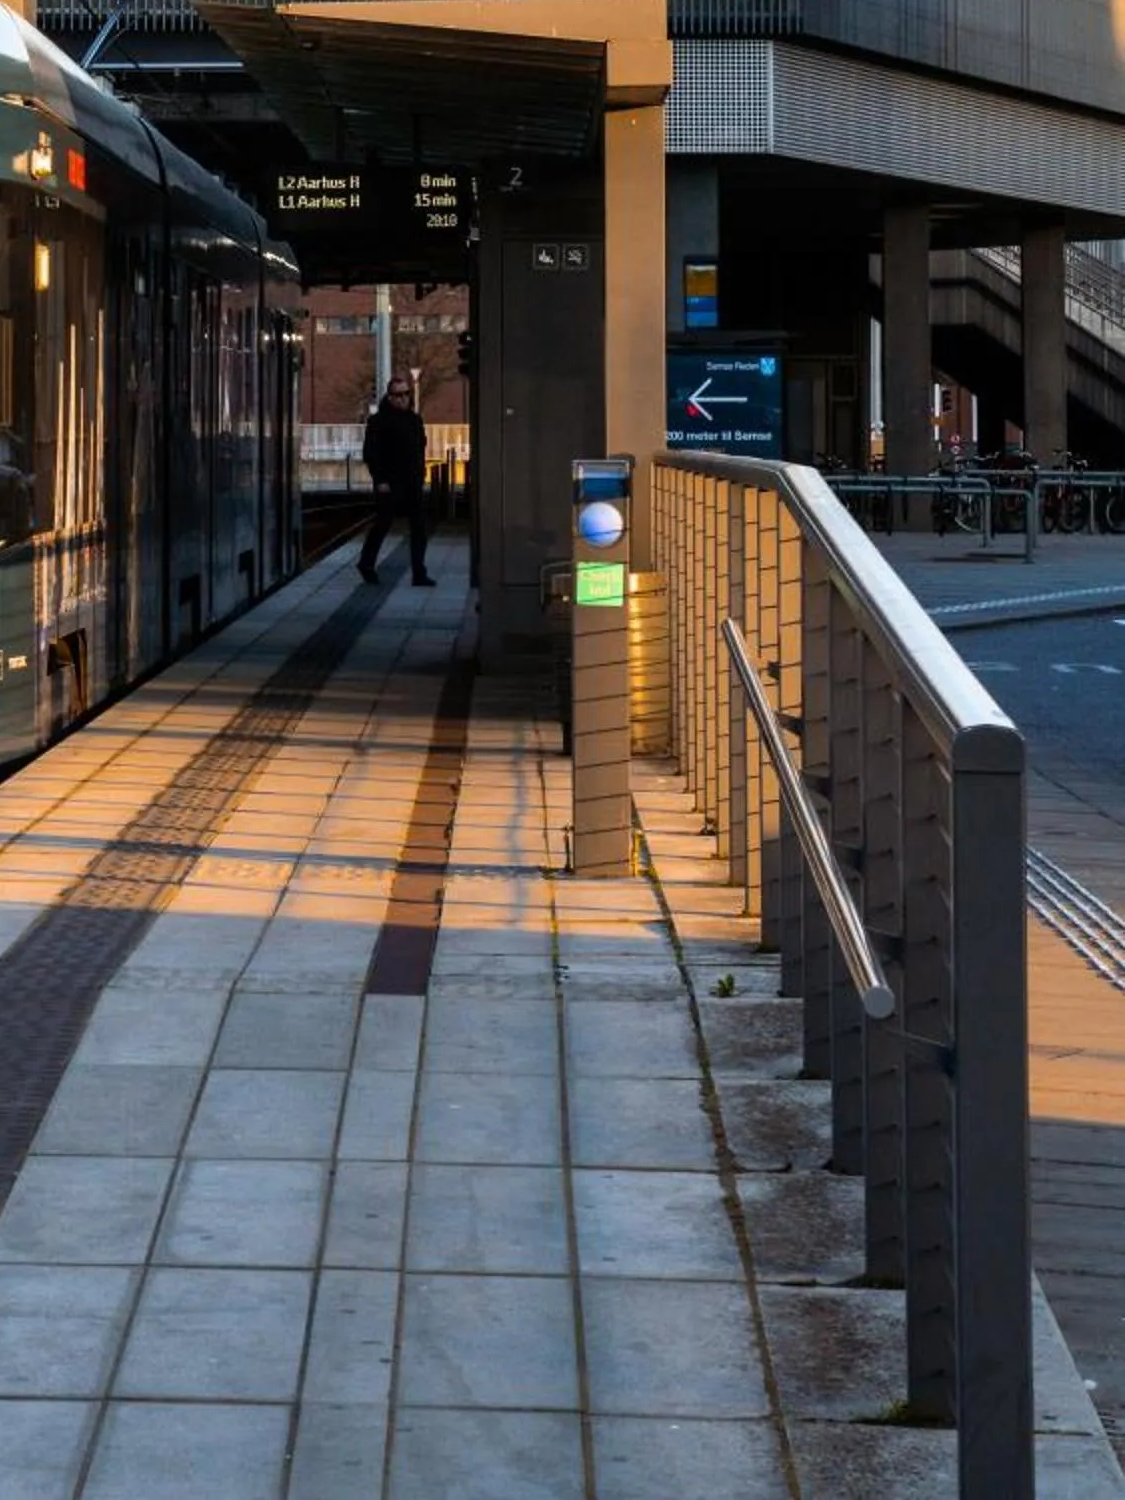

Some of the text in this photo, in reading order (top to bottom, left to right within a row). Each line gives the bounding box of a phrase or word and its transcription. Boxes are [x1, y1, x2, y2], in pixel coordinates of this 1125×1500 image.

[278, 174, 361, 190] L2 Aarhus H
[432, 173, 457, 188] min
[510, 167, 523, 186] 2
[278, 193, 361, 209] L1 Aarhus H
[414, 193, 457, 208] 15 min
[686, 431, 718, 441] meter
